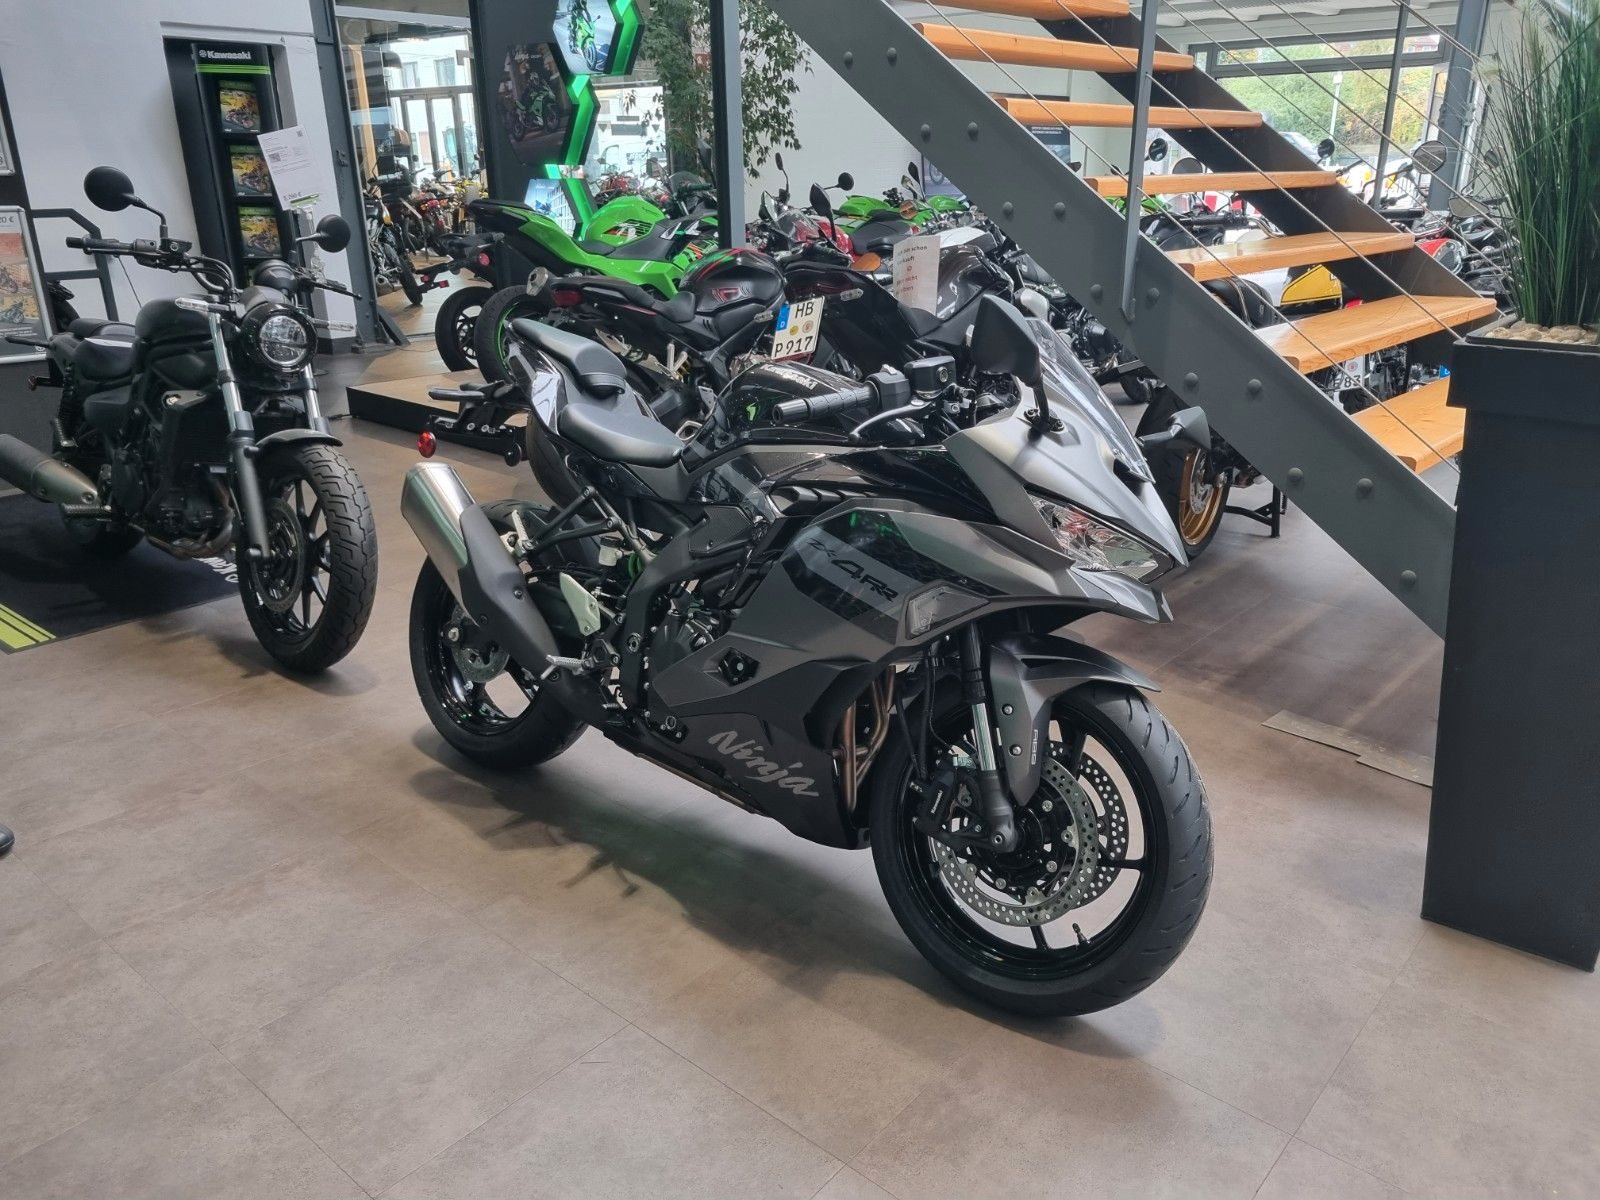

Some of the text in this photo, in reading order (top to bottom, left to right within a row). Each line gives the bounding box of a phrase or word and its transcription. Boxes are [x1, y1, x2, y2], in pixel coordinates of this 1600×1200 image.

[206, 50, 252, 60] Kawasaki
[795, 301, 814, 319] HB
[775, 335, 813, 358] P 917
[760, 363, 818, 390] Kawasaki
[1344, 374, 1361, 388] 83
[707, 730, 820, 797] Ninja
